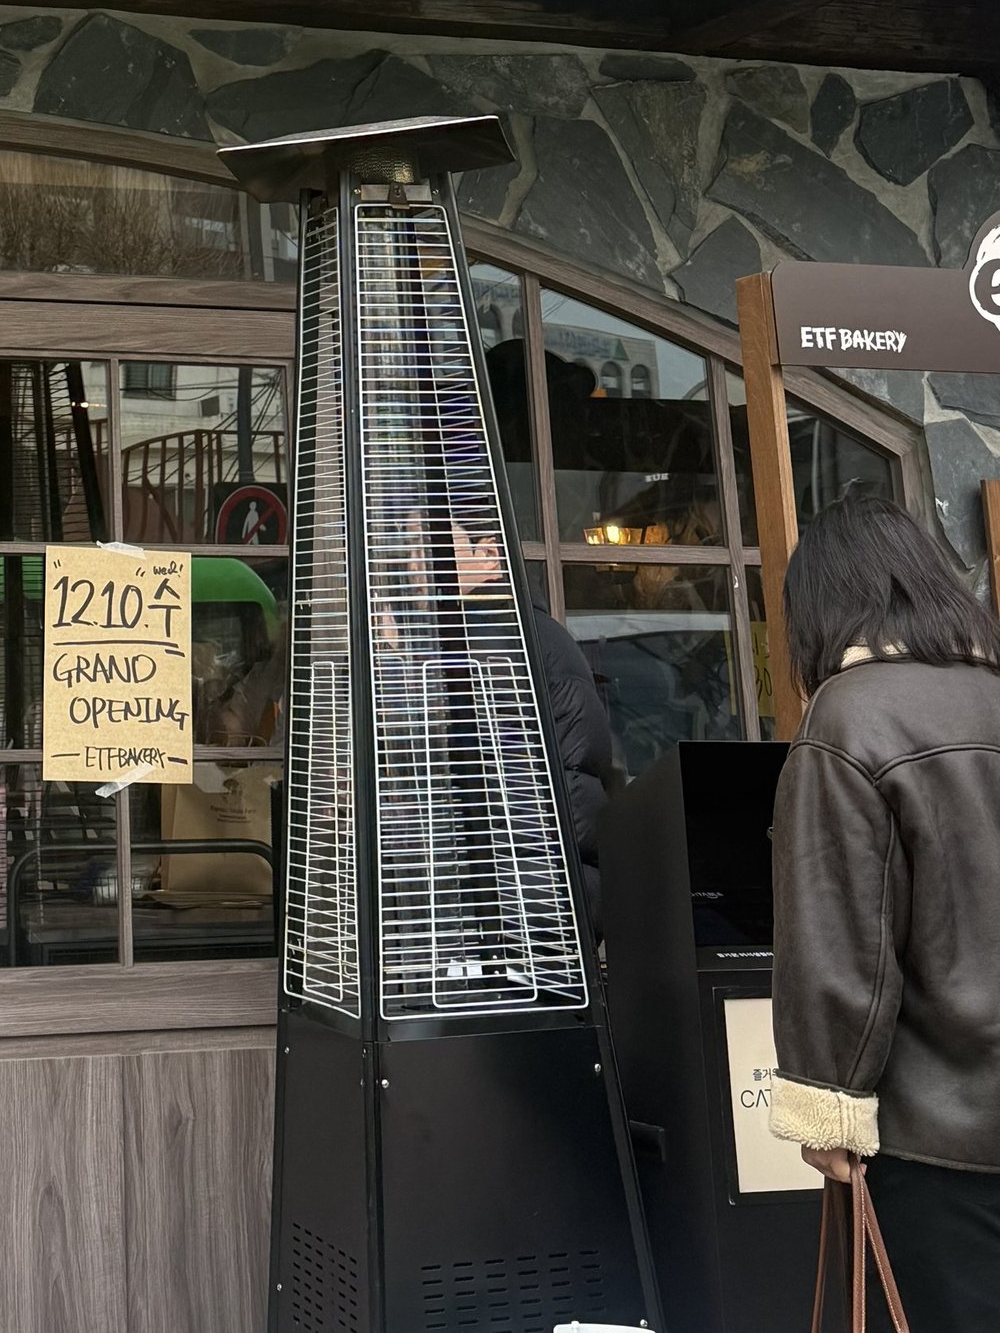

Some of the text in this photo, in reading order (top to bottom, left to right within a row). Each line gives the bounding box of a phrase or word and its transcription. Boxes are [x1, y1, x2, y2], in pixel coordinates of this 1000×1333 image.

[800, 326, 908, 354] ETF BAKERY
[53, 653, 157, 688] GRAND
[69, 697, 189, 731] OPENING
